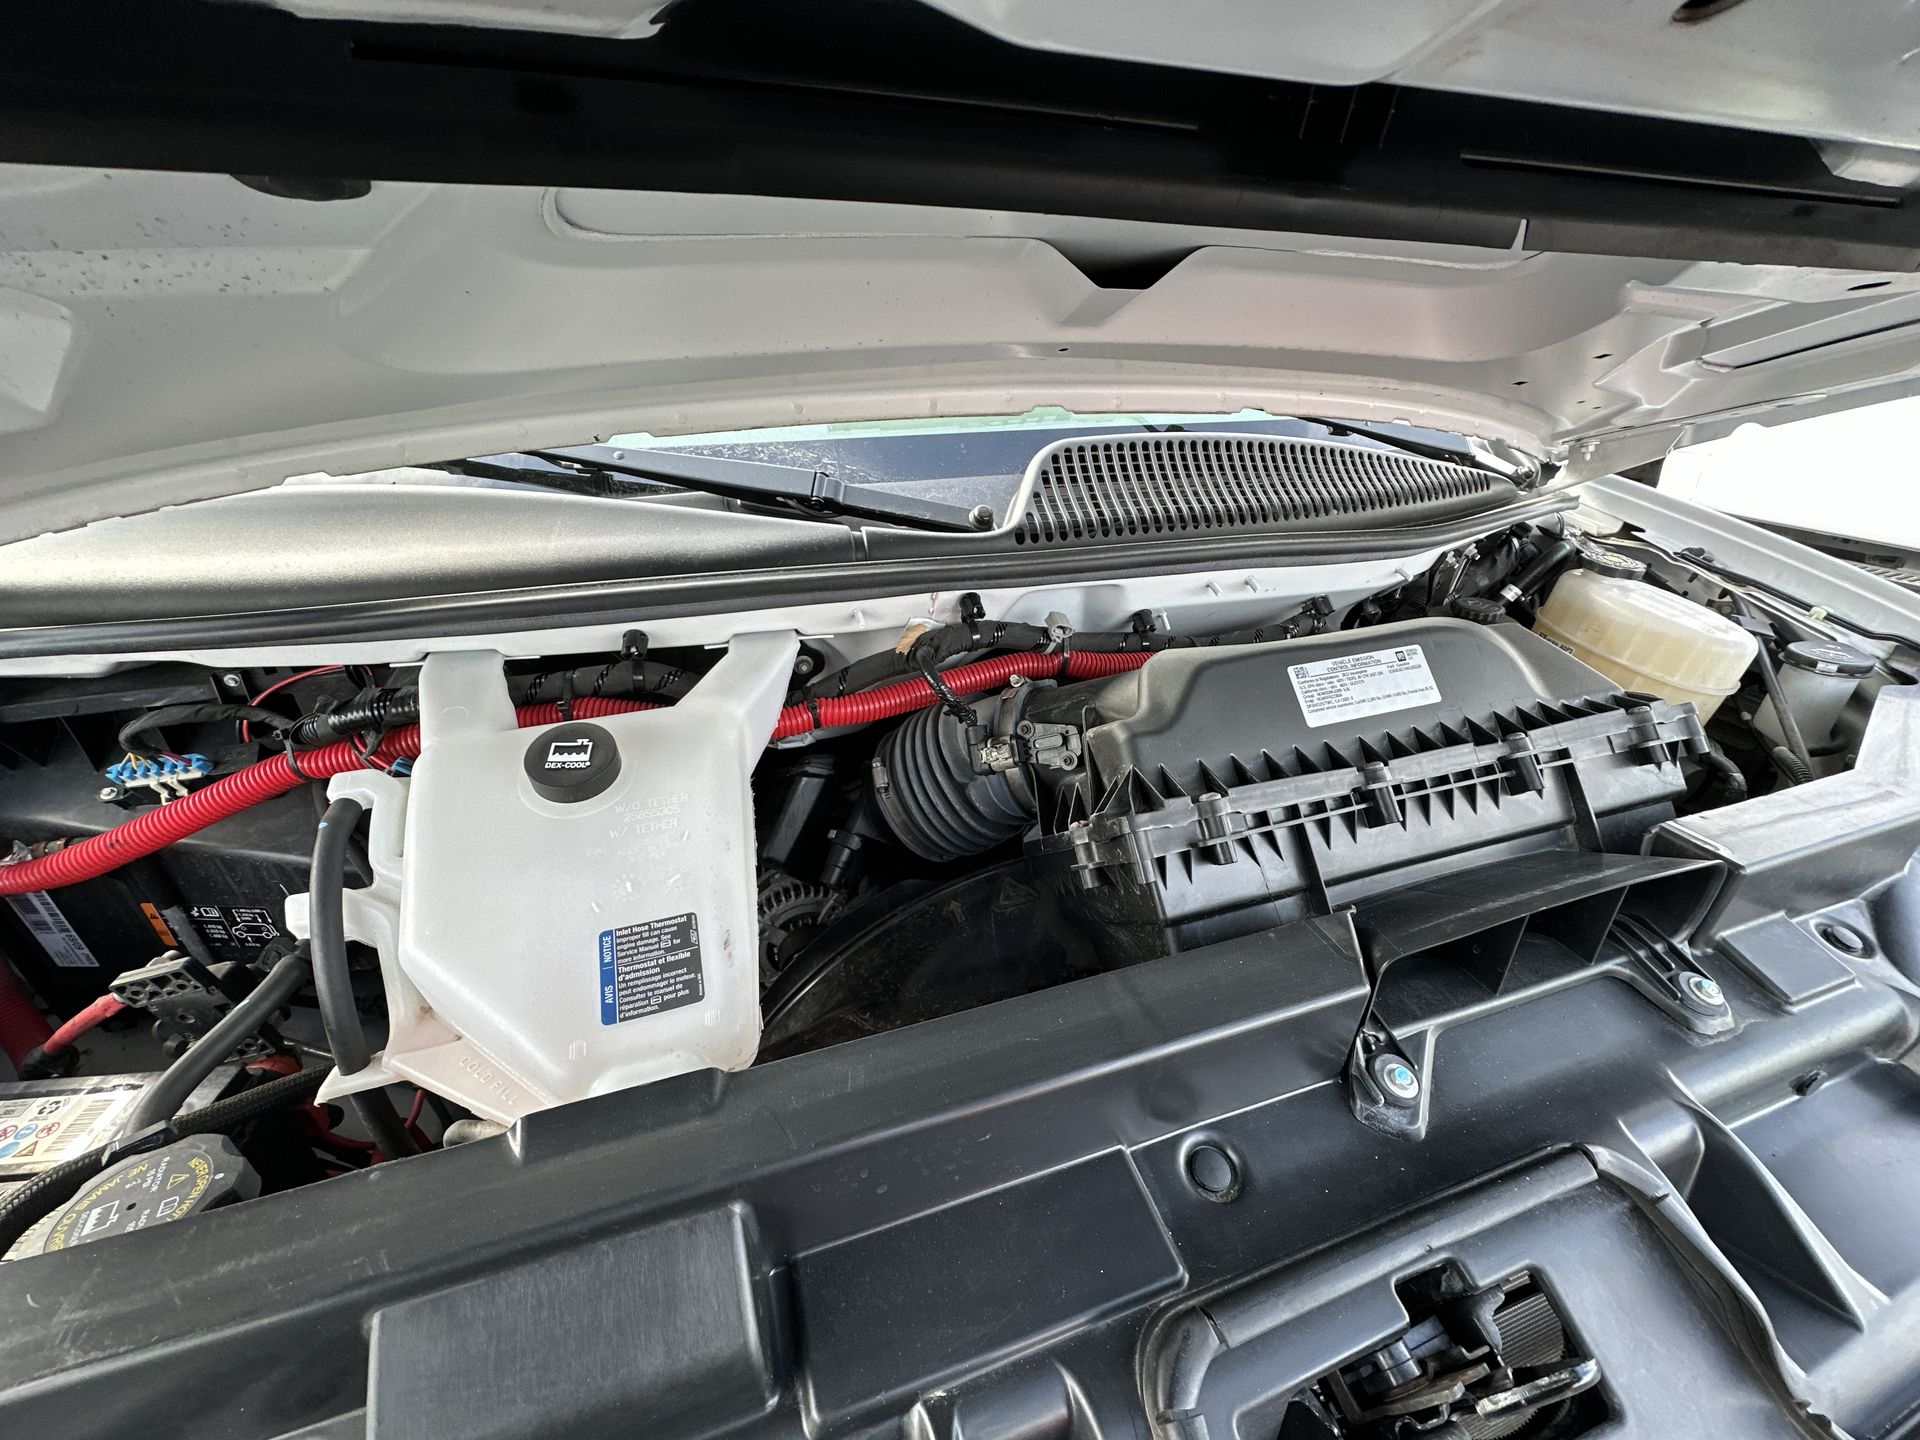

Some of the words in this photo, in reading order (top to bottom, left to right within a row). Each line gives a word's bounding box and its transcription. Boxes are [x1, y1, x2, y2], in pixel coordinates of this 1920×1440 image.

[1327, 665, 1350, 673] CONTROL
[1350, 659, 1382, 668] INFORMATION
[634, 818, 678, 834] TETHER
[616, 928, 631, 936] Inlet
[633, 924, 649, 933] Hose
[650, 916, 687, 928] Thermostat
[603, 936, 612, 963] NOTICE
[616, 934, 641, 944] Improper
[617, 942, 635, 951] engine
[636, 937, 660, 947] damage.
[617, 948, 638, 958] Service
[639, 943, 659, 953] Manual
[633, 949, 666, 961] information.
[618, 959, 657, 974] Thermostat
[666, 951, 691, 962] flexible
[618, 966, 660, 982] d'admission
[628, 973, 662, 988] remplissage
[663, 967, 687, 978] incorrect
[605, 984, 614, 1005] AVIS
[619, 989, 632, 998] peut
[633, 979, 669, 994] endommager
[676, 972, 696, 982] moteur.
[620, 992, 646, 1004] Consulter
[654, 985, 675, 995] manuel
[620, 998, 649, 1013] réparation
[663, 992, 677, 1001] pour
[677, 988, 690, 998] plus
[620, 1003, 660, 1019] d'information.
[459, 1056, 493, 1084] COLD
[489, 1081, 519, 1106] FILL
[130, 1163, 148, 1177] NE
[149, 1156, 169, 1193] RADIATOR
[188, 1157, 208, 1178] NEVER
[75, 1175, 123, 1211] JAMAIS
[187, 1174, 208, 1199] OPEN
[135, 1208, 150, 1231] RADI
